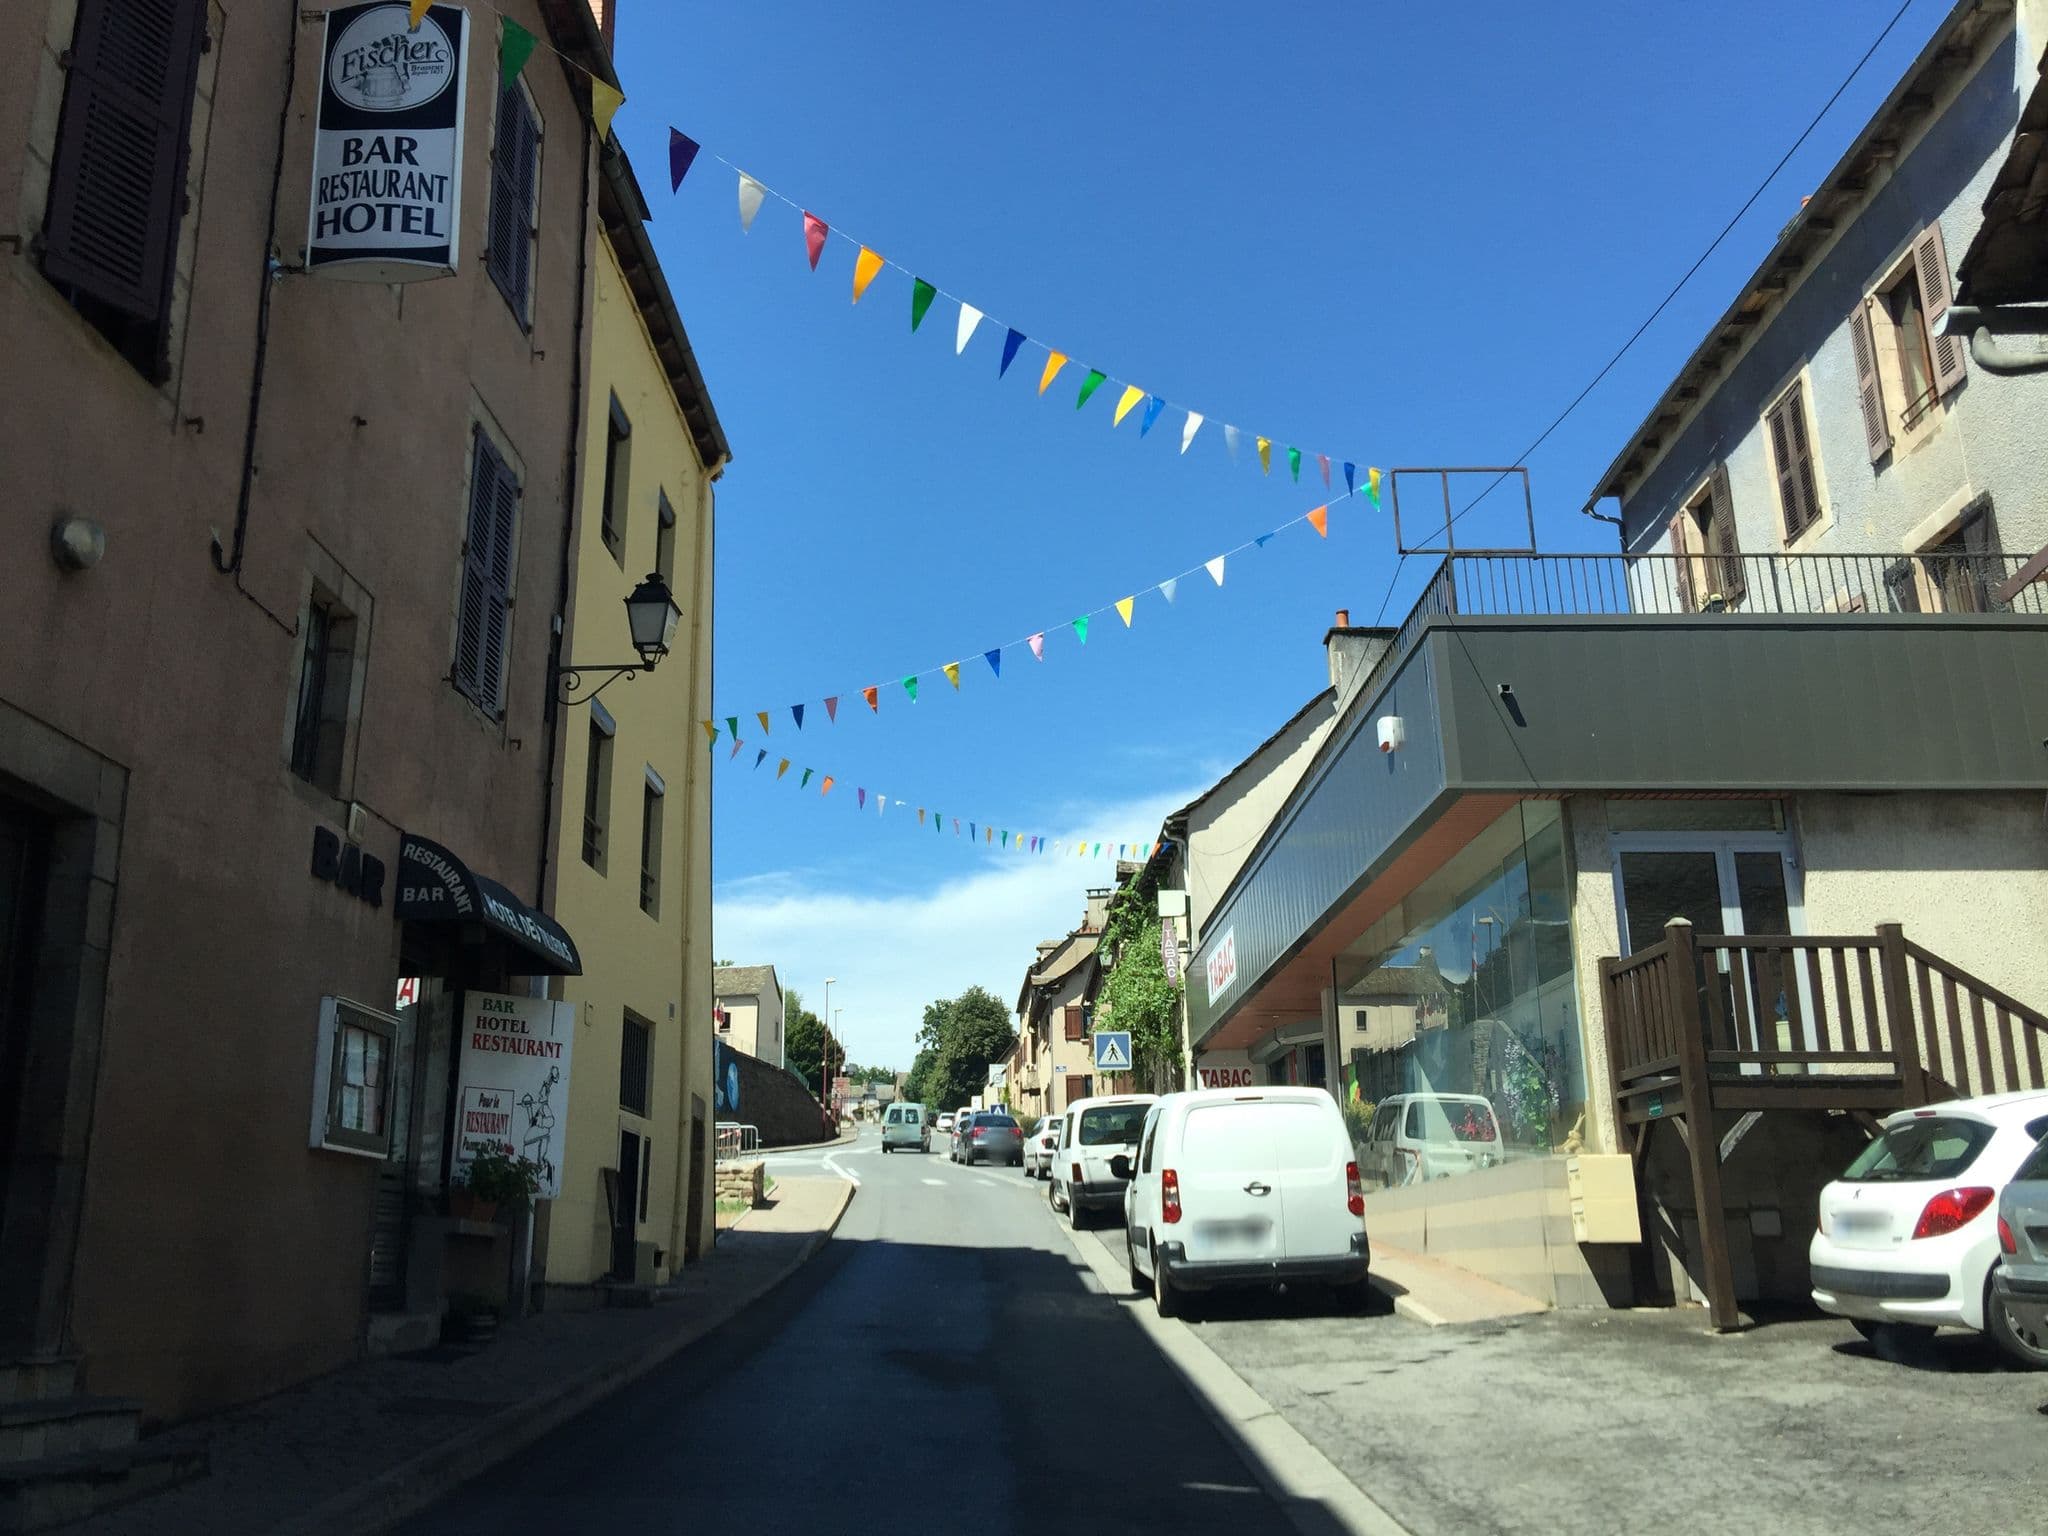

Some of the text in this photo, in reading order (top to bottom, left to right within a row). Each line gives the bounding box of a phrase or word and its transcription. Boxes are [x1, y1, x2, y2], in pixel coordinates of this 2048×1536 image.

[341, 35, 446, 81] Fischer
[342, 136, 419, 167] BAR
[318, 169, 449, 206] RESTAURANT
[316, 203, 445, 240] HOTEL
[311, 825, 386, 907] BAR
[403, 843, 473, 914] RESTAURANT
[403, 887, 444, 902] BAR
[1164, 929, 1176, 978] TABAC
[1208, 937, 1235, 994] TABAC
[482, 998, 515, 1014] BAR
[476, 1015, 530, 1035] HOTEL
[471, 1033, 564, 1059] RESTAURANT
[1199, 1068, 1252, 1088] TABAC
[465, 1111, 510, 1135] RESTAURANT
